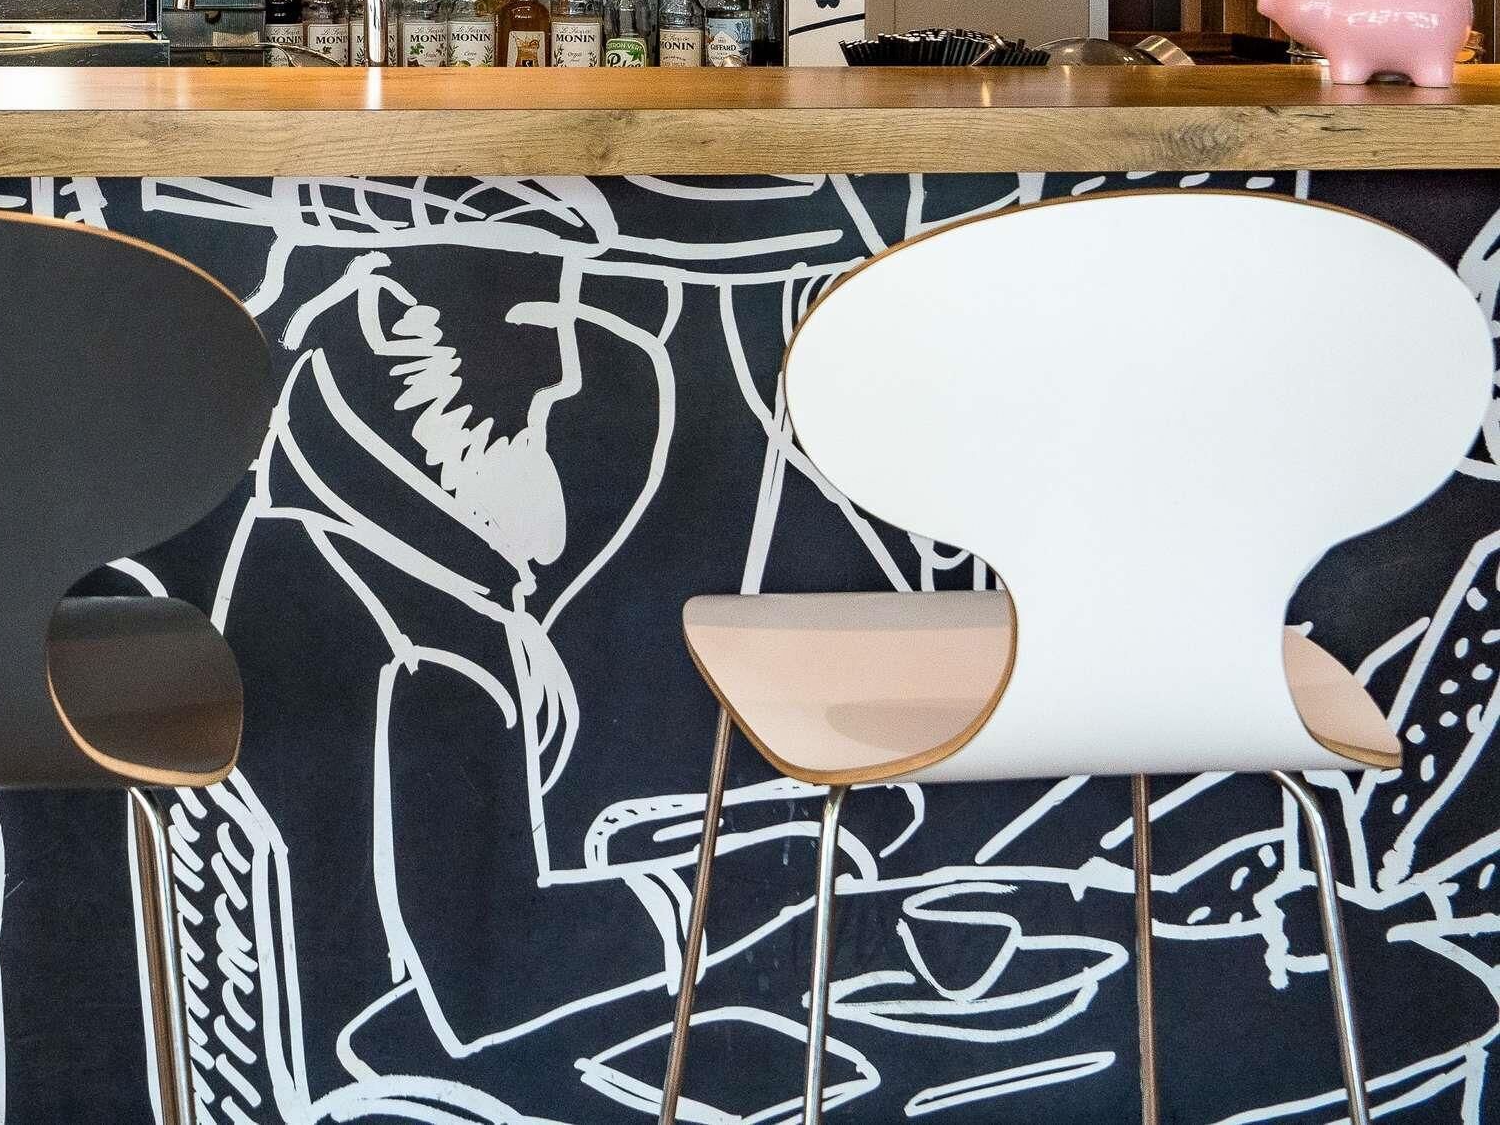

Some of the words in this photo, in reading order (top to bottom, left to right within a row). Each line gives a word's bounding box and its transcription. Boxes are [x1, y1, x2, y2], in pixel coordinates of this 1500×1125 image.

[451, 33, 491, 42] MONIN
[556, 34, 595, 43] MONIN
[711, 44, 736, 52] GIFFARD
